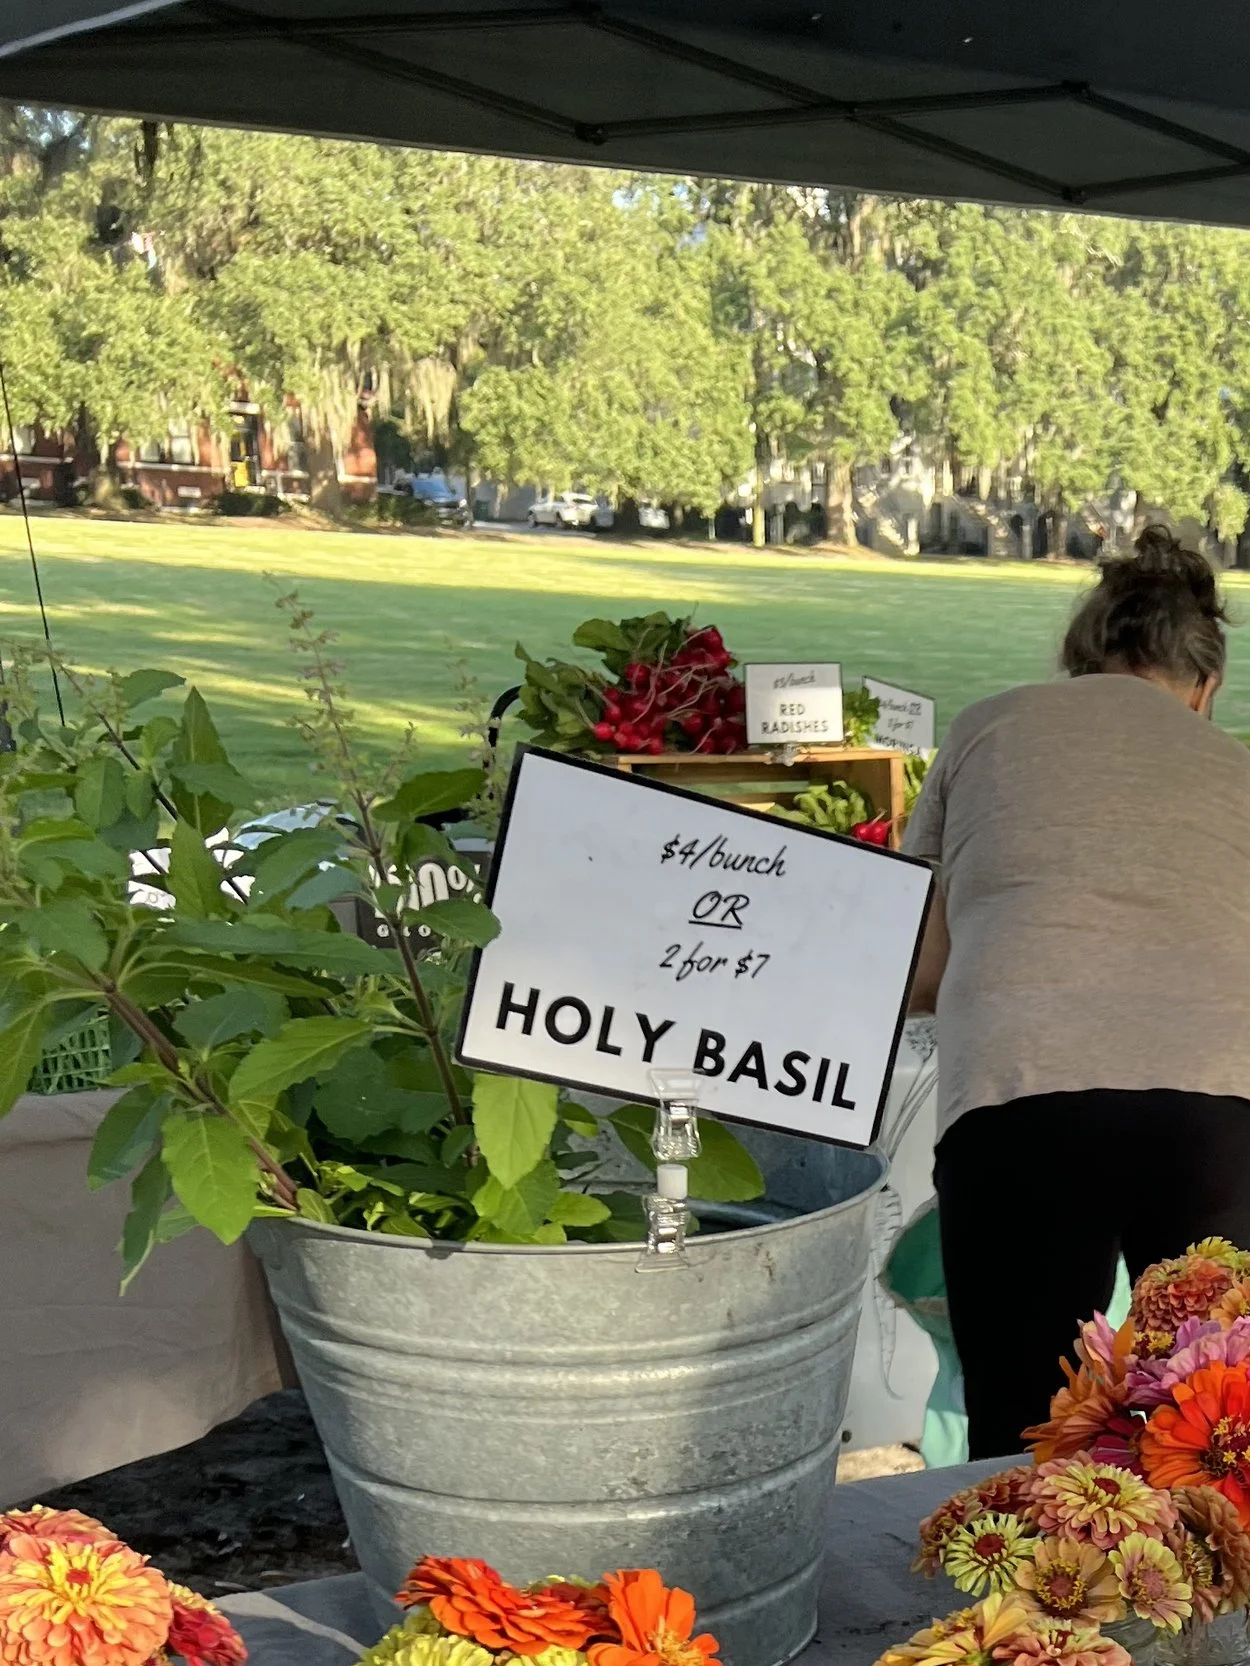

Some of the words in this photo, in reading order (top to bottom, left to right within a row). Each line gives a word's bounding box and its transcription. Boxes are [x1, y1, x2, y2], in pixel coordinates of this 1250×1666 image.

[760, 719, 830, 736] RADISHES
[779, 703, 807, 717] RED
[660, 834, 788, 877] $4/bunch
[690, 890, 750, 927] OR
[658, 943, 682, 969] 2
[675, 940, 729, 982] for
[734, 948, 772, 979] $7
[495, 980, 677, 1064] HOLY
[692, 1027, 857, 1112] BASIL
